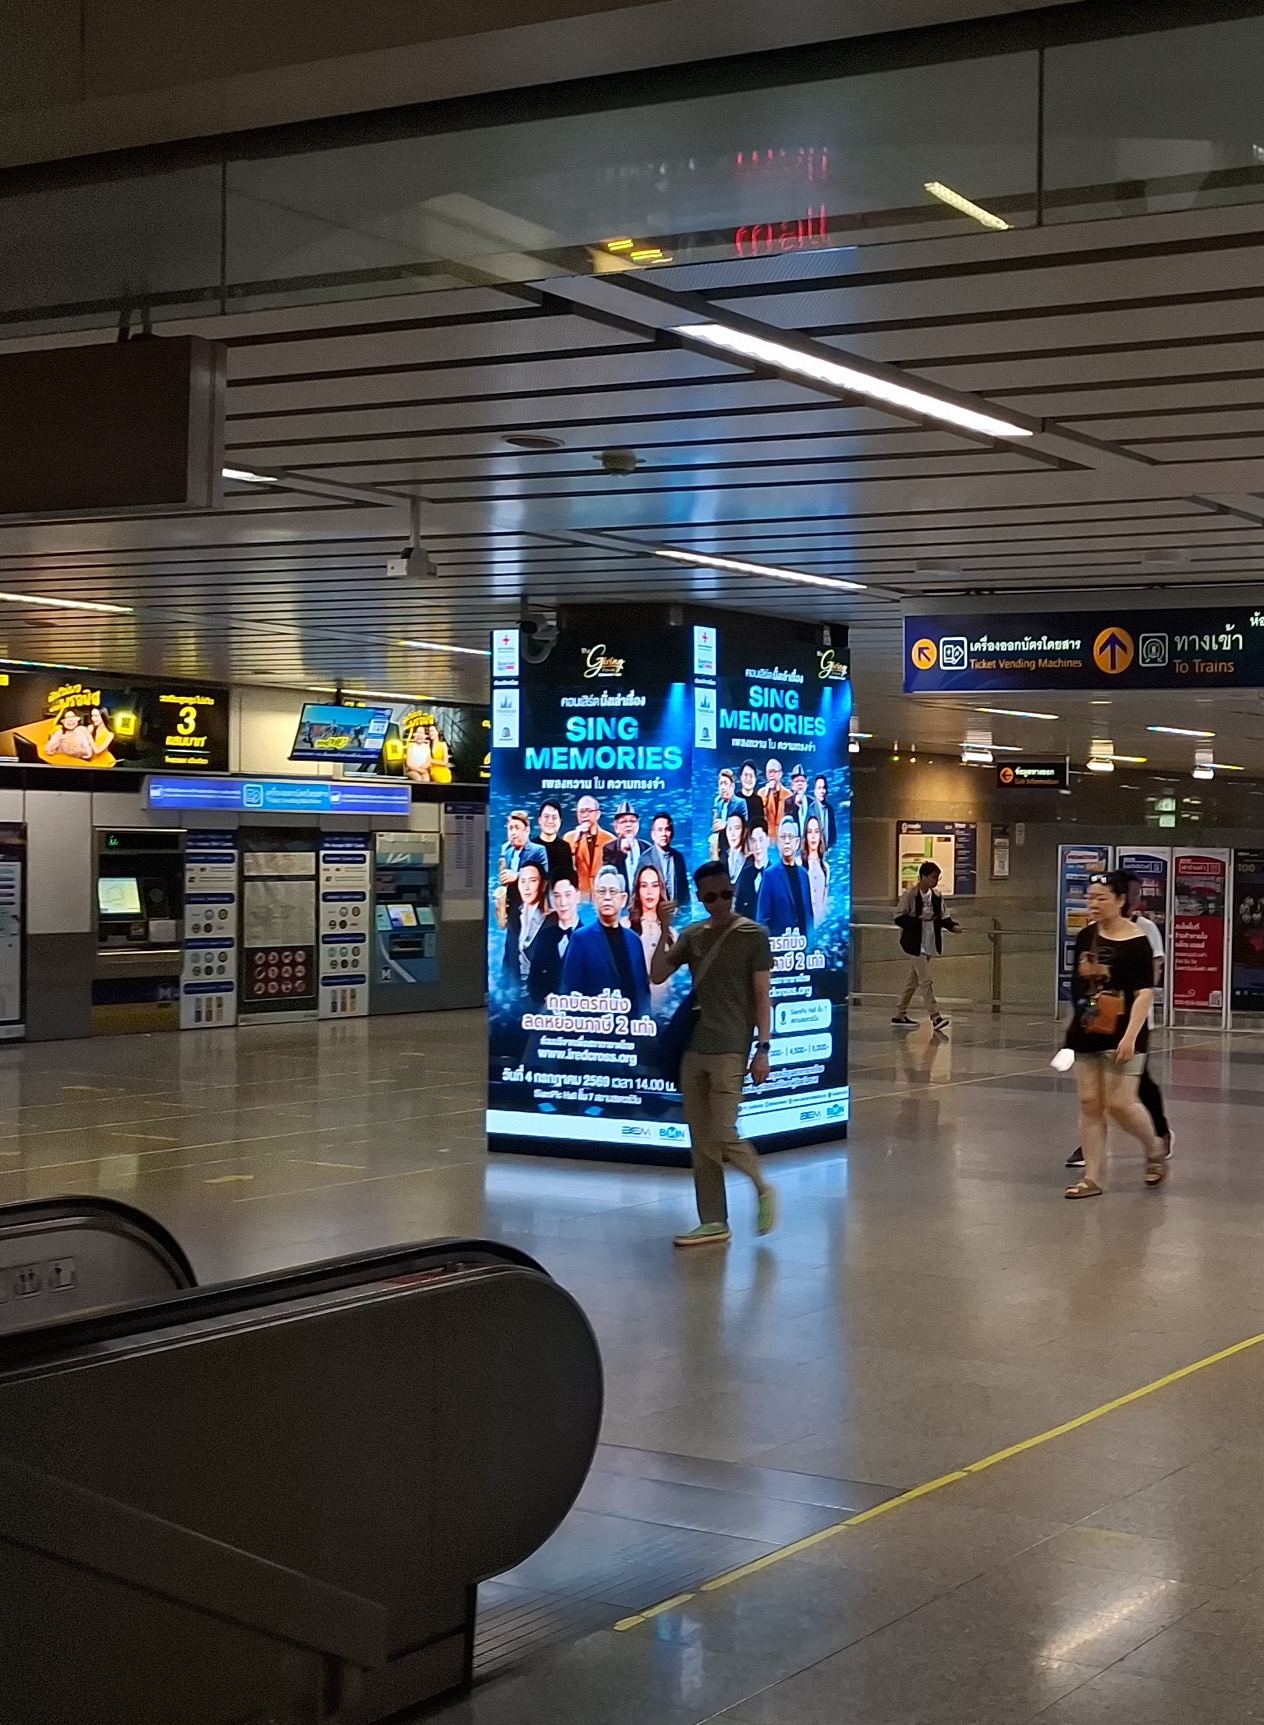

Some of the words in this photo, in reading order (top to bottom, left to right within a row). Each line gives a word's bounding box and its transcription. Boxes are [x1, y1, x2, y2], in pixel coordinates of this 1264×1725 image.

[969, 634, 1081, 652] เครื่องออกบัตรโดยสาร
[1174, 624, 1243, 651] ทางเข้า
[969, 658, 997, 670] Ticket
[998, 659, 1037, 671] Vending
[1038, 657, 1083, 669] Machines
[1173, 659, 1190, 674] To
[1193, 659, 1235, 674] Trains
[749, 685, 800, 710] SING
[177, 706, 197, 735] 3
[566, 715, 639, 742] SING
[719, 709, 827, 737] MEMORIES
[524, 746, 683, 771] MEMORIES
[616, 1016, 628, 1034] 2
[631, 1016, 656, 1035] เท่า
[537, 1048, 638, 1066] www.iredcross.org
[525, 1074, 532, 1083] 4
[635, 1078, 665, 1091] 14.00
